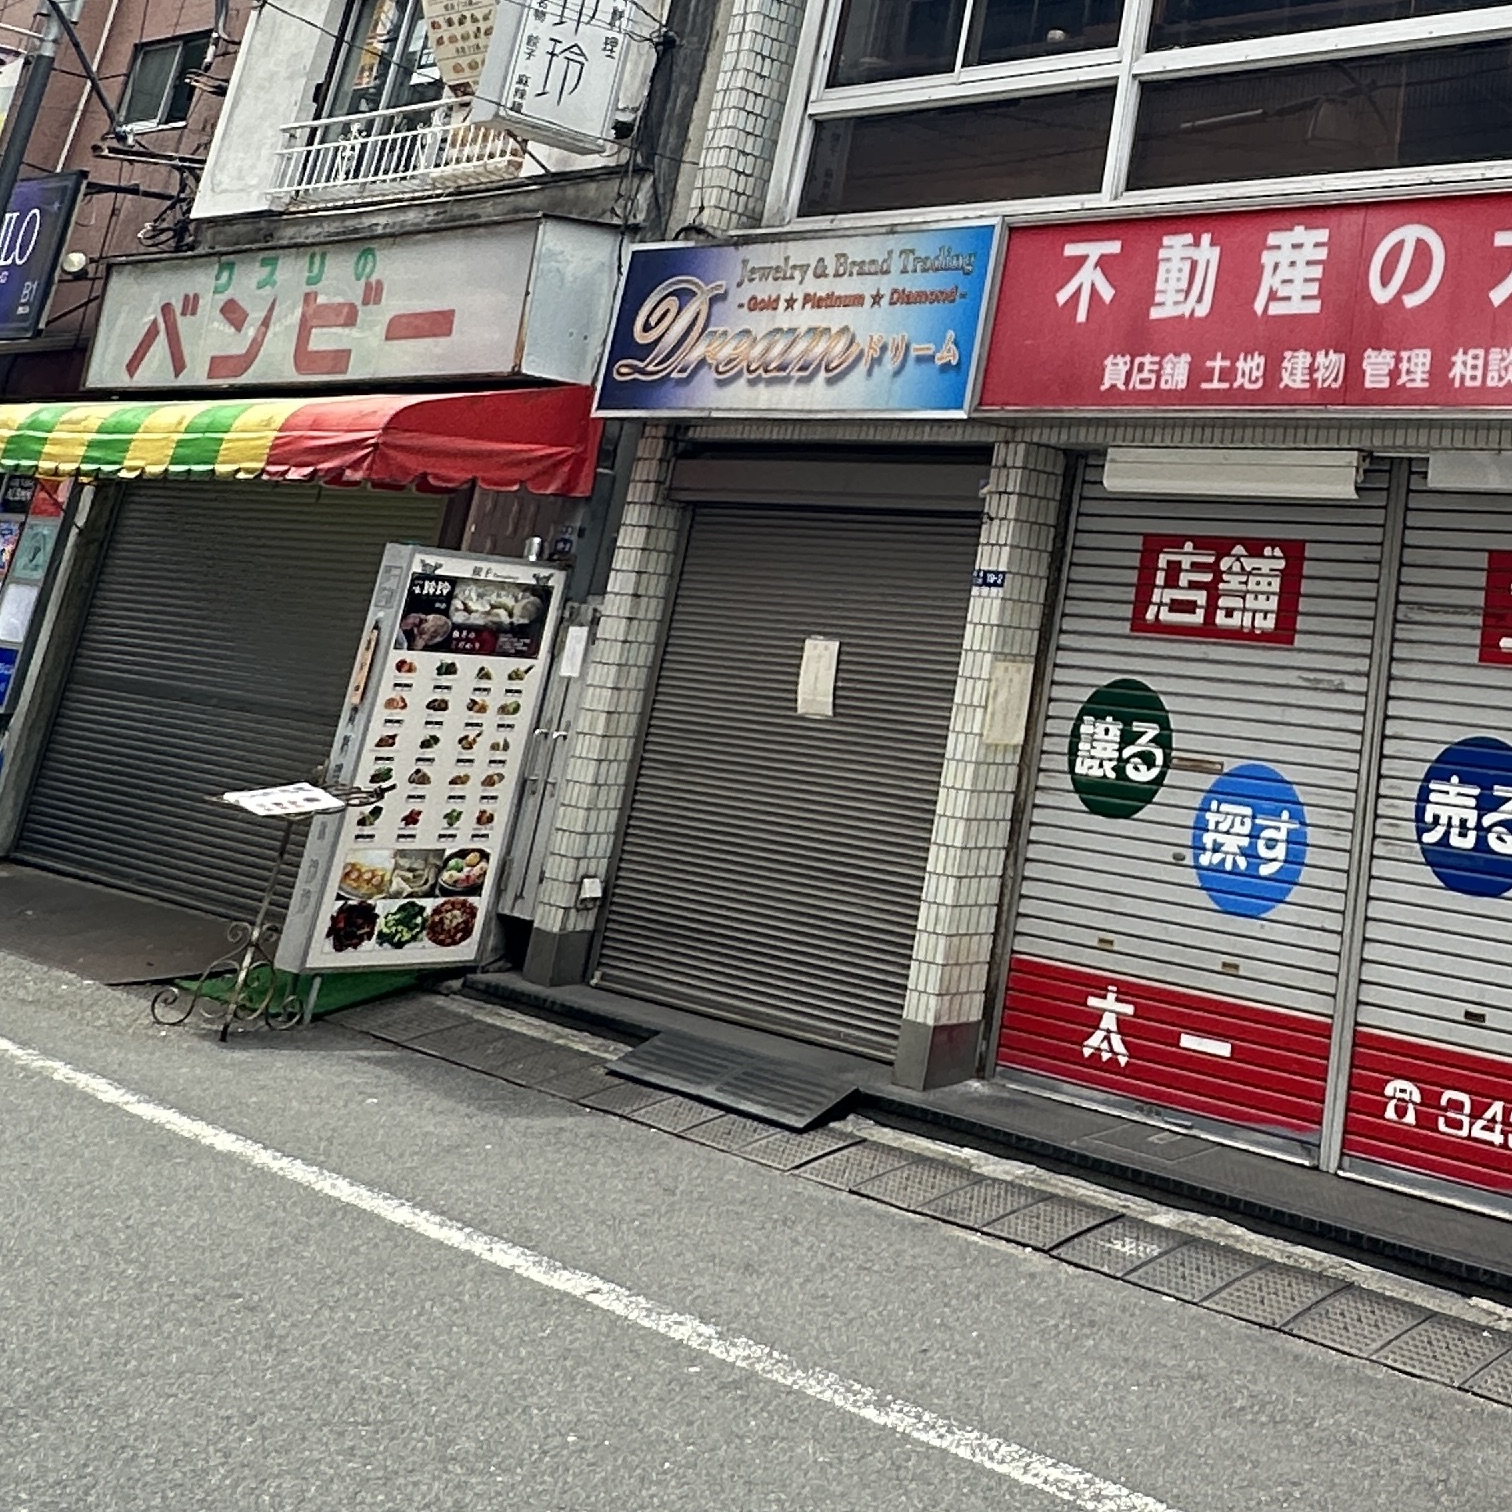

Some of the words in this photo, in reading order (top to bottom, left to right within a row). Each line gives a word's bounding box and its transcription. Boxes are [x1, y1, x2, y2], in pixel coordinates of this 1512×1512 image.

[737, 254, 811, 287] Jewelry
[813, 256, 828, 279] &
[832, 249, 892, 279] Brand
[898, 245, 976, 277] Trading
[125, 278, 456, 380] バンビー
[613, 275, 861, 382] Dream
[862, 329, 960, 376] ドリーム
[1100, 353, 1192, 391] 貸店舗
[1200, 351, 1266, 390] 土地
[1278, 349, 1346, 389] 建物
[1362, 348, 1432, 389] 管理
[1146, 540, 1286, 634] 店舗
[1075, 714, 1165, 782] 譲る
[1200, 799, 1301, 876] 探す
[1082, 985, 1233, 1068] 太一
